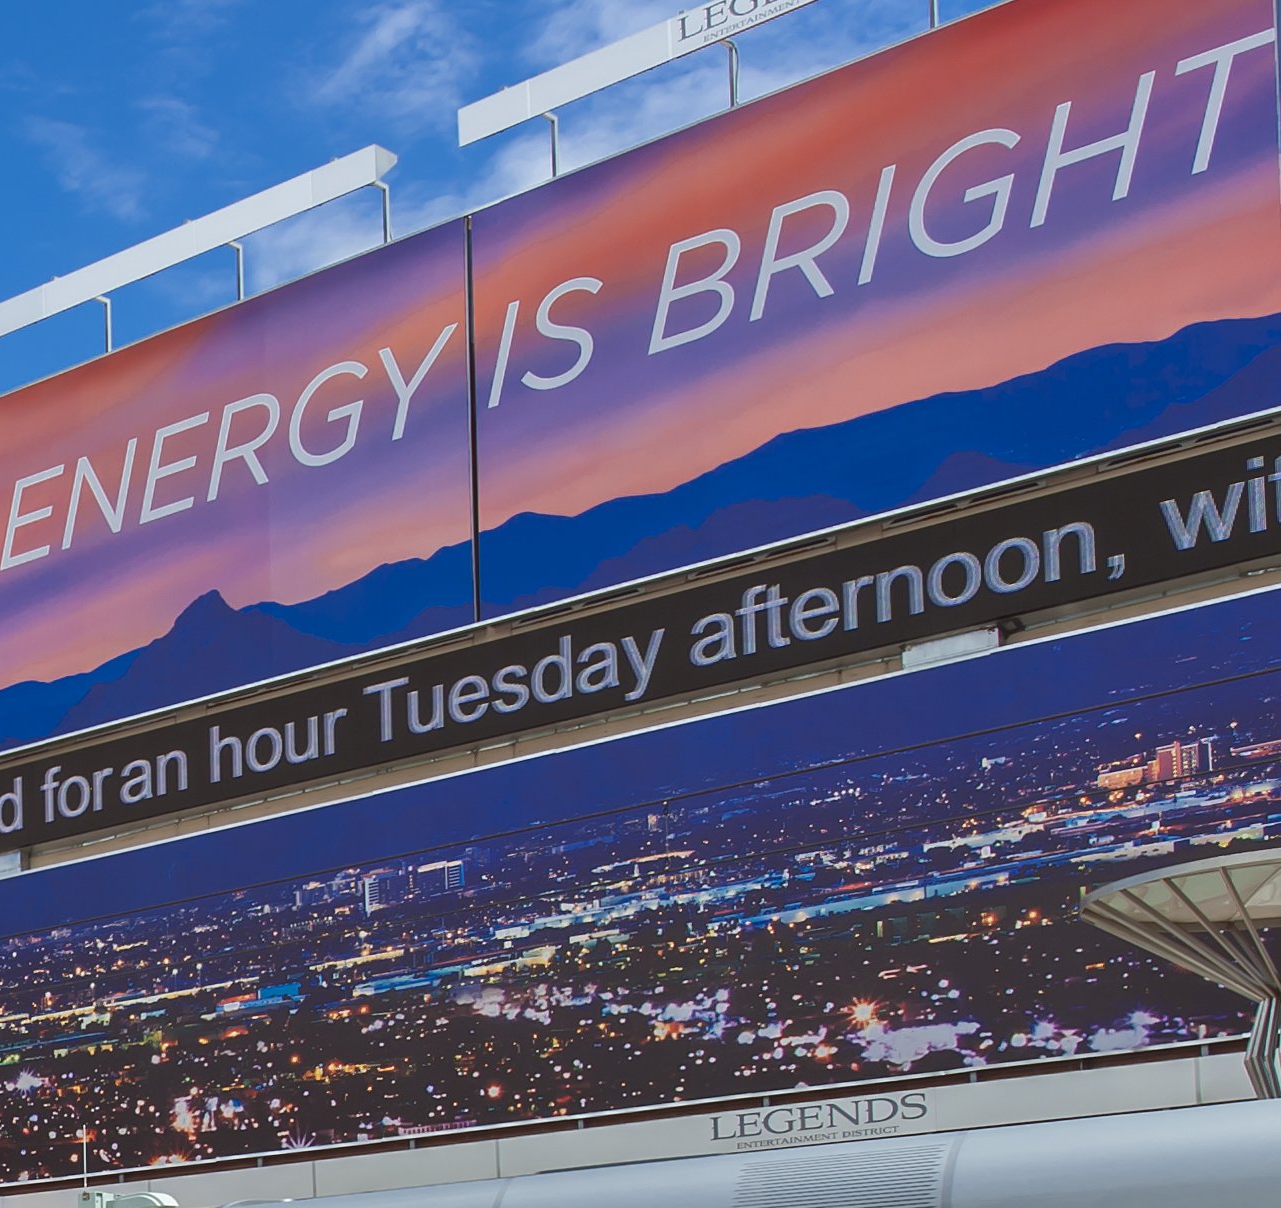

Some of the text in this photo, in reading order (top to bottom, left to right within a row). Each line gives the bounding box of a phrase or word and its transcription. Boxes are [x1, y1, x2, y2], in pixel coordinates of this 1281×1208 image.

[0, 29, 1276, 571] ENERGY IS BRIGHT
[39, 765, 111, 823] for
[120, 749, 188, 805] an
[210, 707, 347, 783] hour
[363, 630, 665, 743] Tuesday
[689, 521, 1126, 667] afternoon,
[710, 1093, 928, 1141] LEGENDS
[736, 1125, 900, 1150] ENTERTAINMENT DISTRICT
